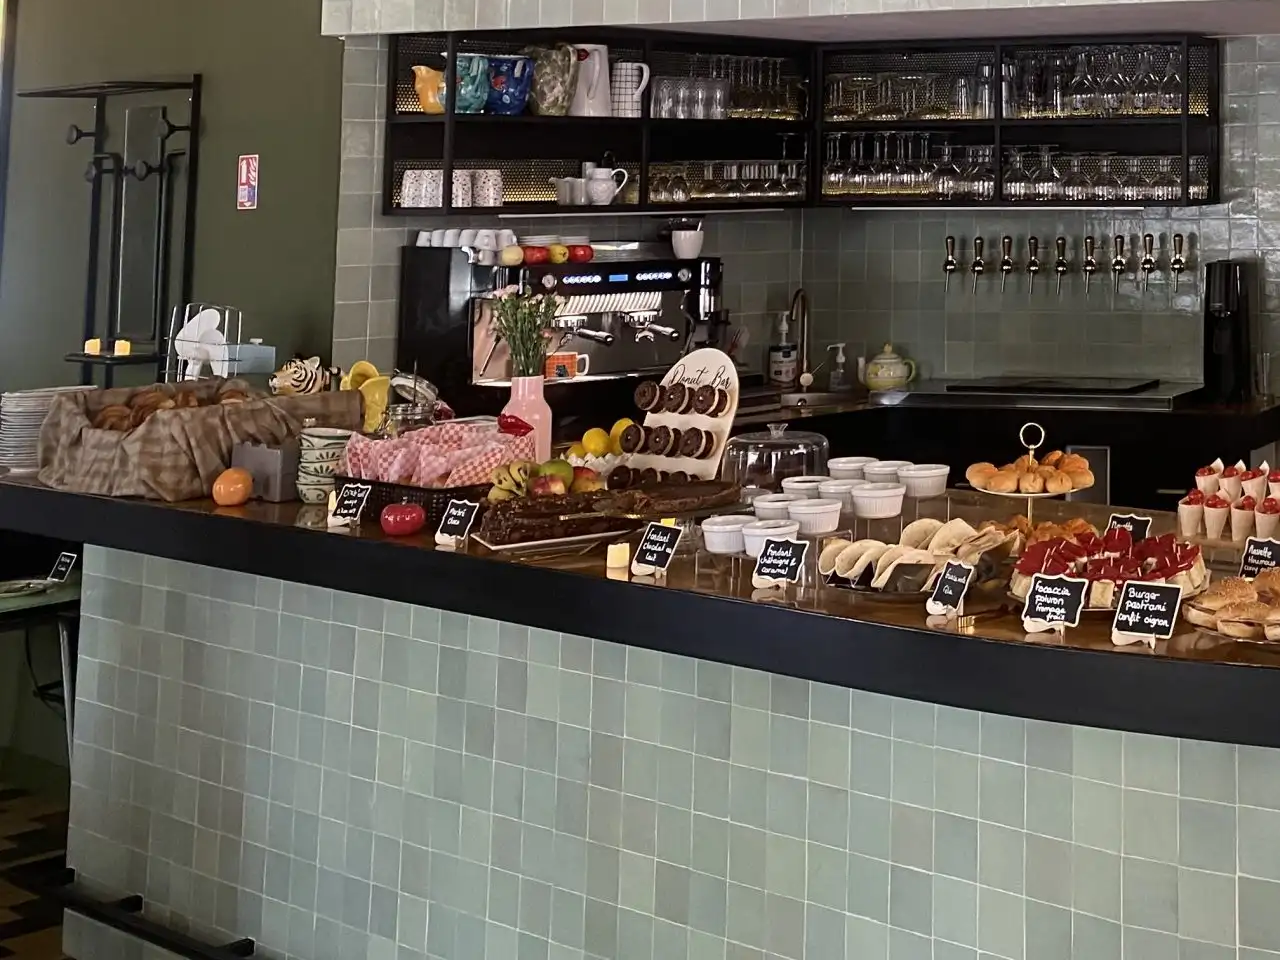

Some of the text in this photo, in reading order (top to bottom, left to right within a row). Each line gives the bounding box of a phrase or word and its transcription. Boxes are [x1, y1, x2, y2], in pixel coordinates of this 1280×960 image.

[668, 364, 731, 389] Donut Bar
[1128, 587, 1160, 602] Burger
[1118, 611, 1170, 628] confit oignon
